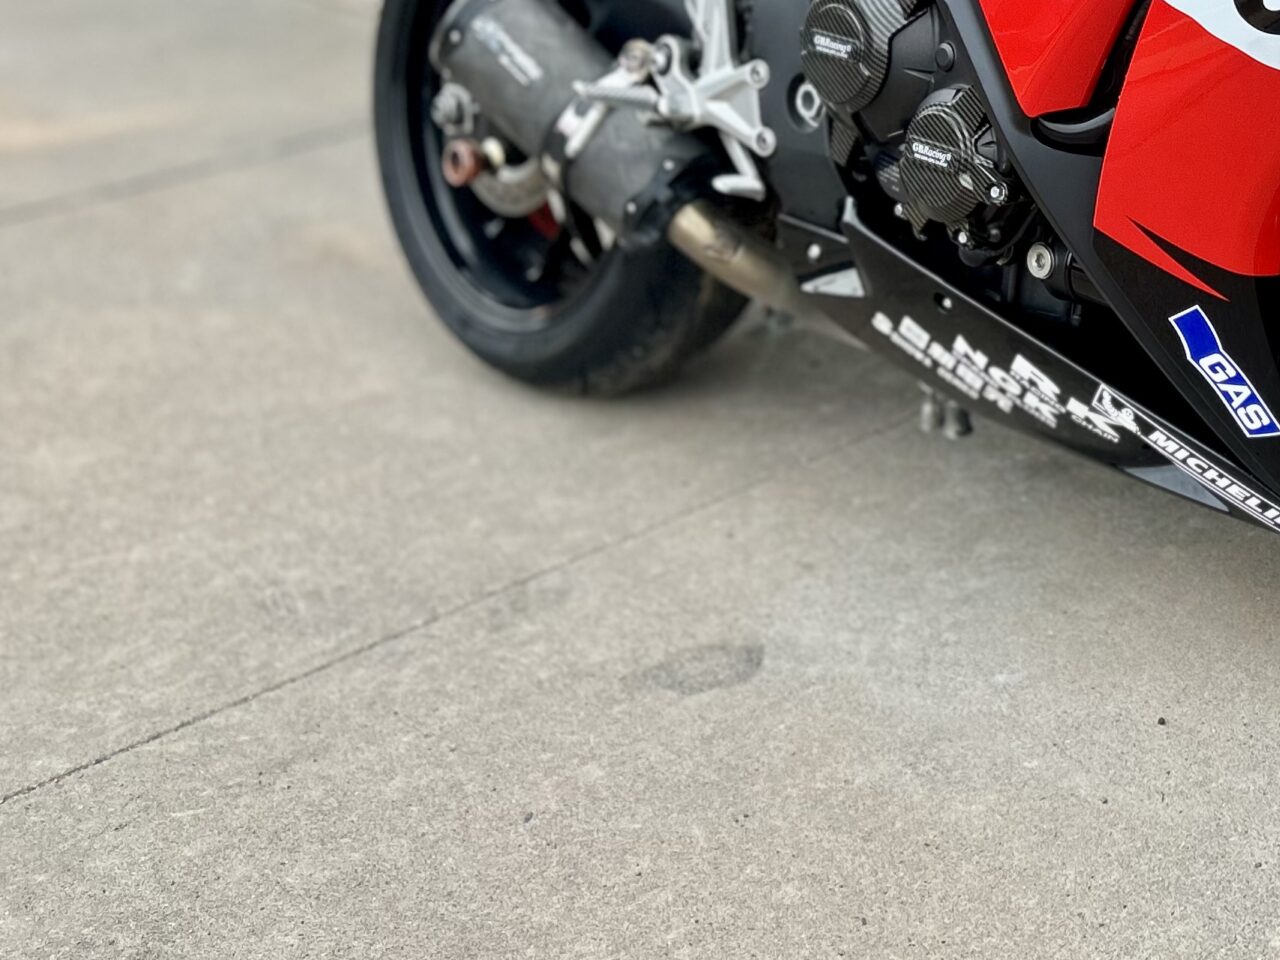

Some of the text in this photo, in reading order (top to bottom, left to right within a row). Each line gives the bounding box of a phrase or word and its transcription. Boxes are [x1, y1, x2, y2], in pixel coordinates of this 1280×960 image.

[1010, 353, 1121, 437] RK
[1071, 414, 1120, 443] CHAIN
[1197, 352, 1271, 432] GAS
